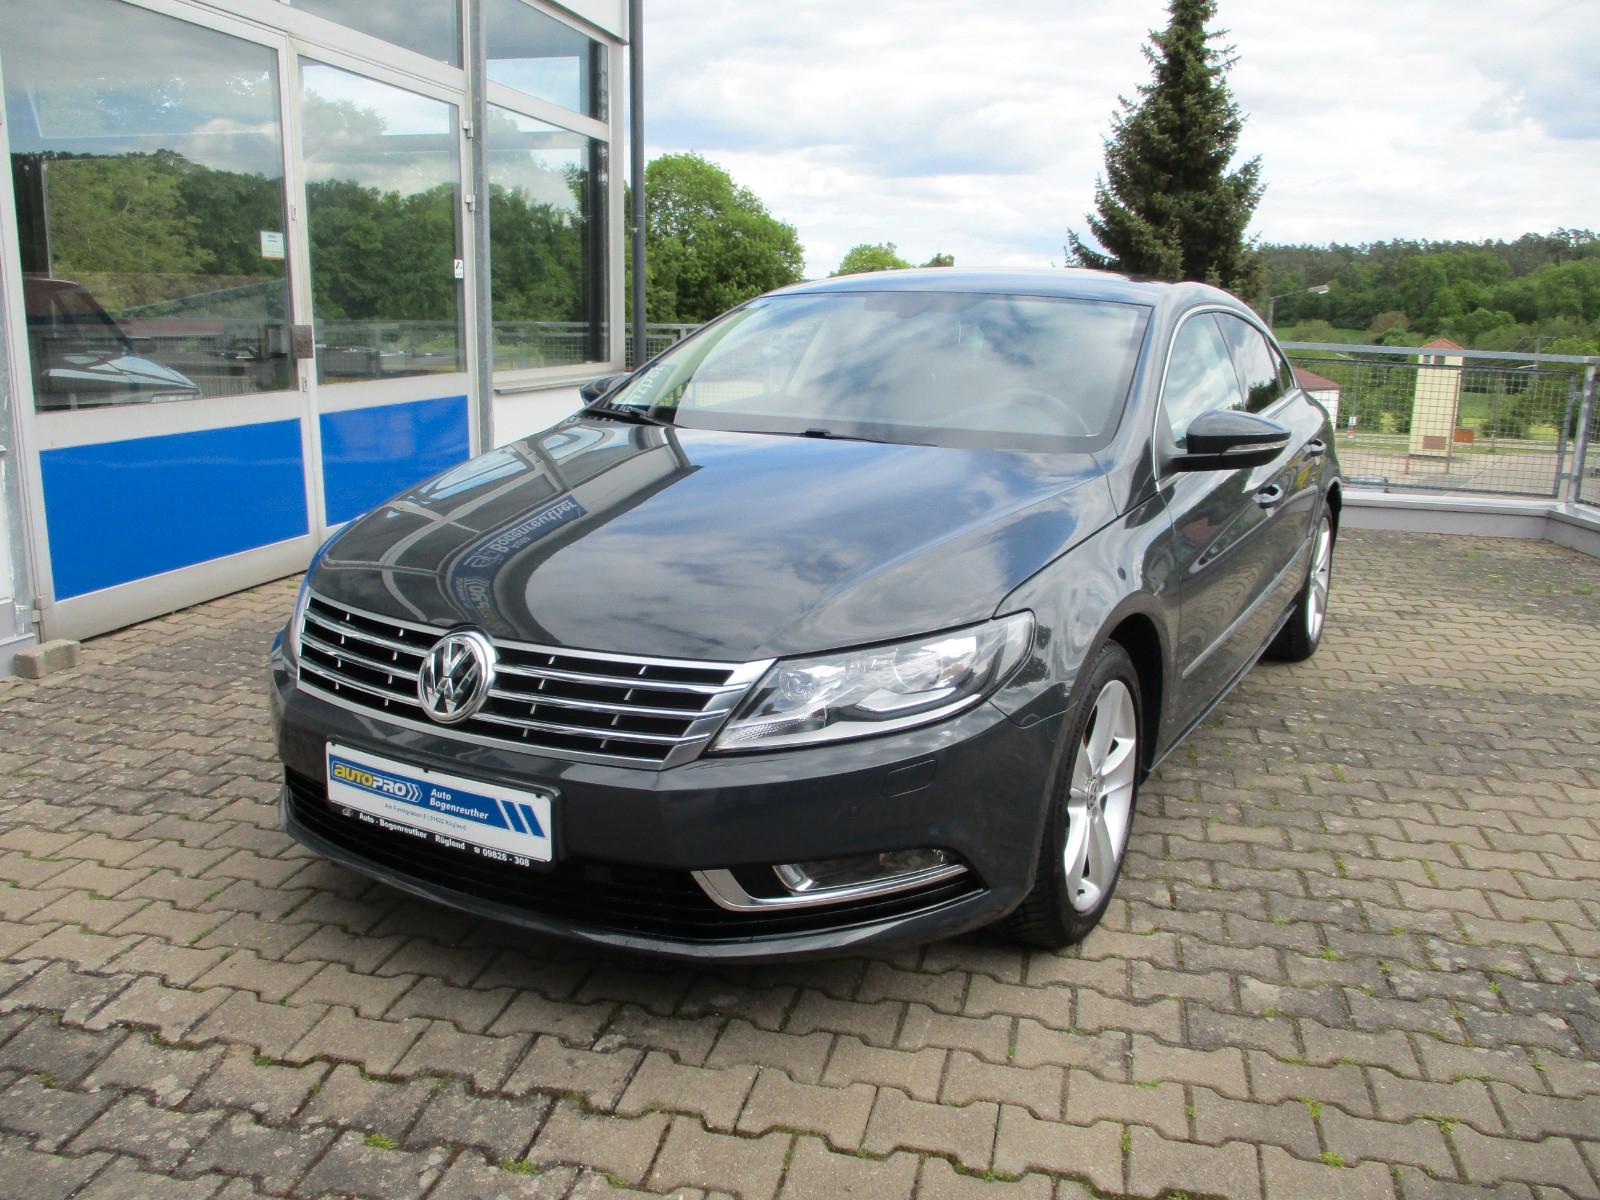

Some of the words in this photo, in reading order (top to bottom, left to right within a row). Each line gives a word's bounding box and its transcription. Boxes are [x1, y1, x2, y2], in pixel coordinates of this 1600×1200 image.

[431, 788, 452, 801] Auto
[430, 797, 489, 820] Bogenreuther
[359, 812, 375, 824] Auto
[379, 818, 428, 839] Bogenreuther
[434, 834, 466, 850] Rügland
[482, 848, 507, 862] 09828
[514, 856, 530, 867] 308
